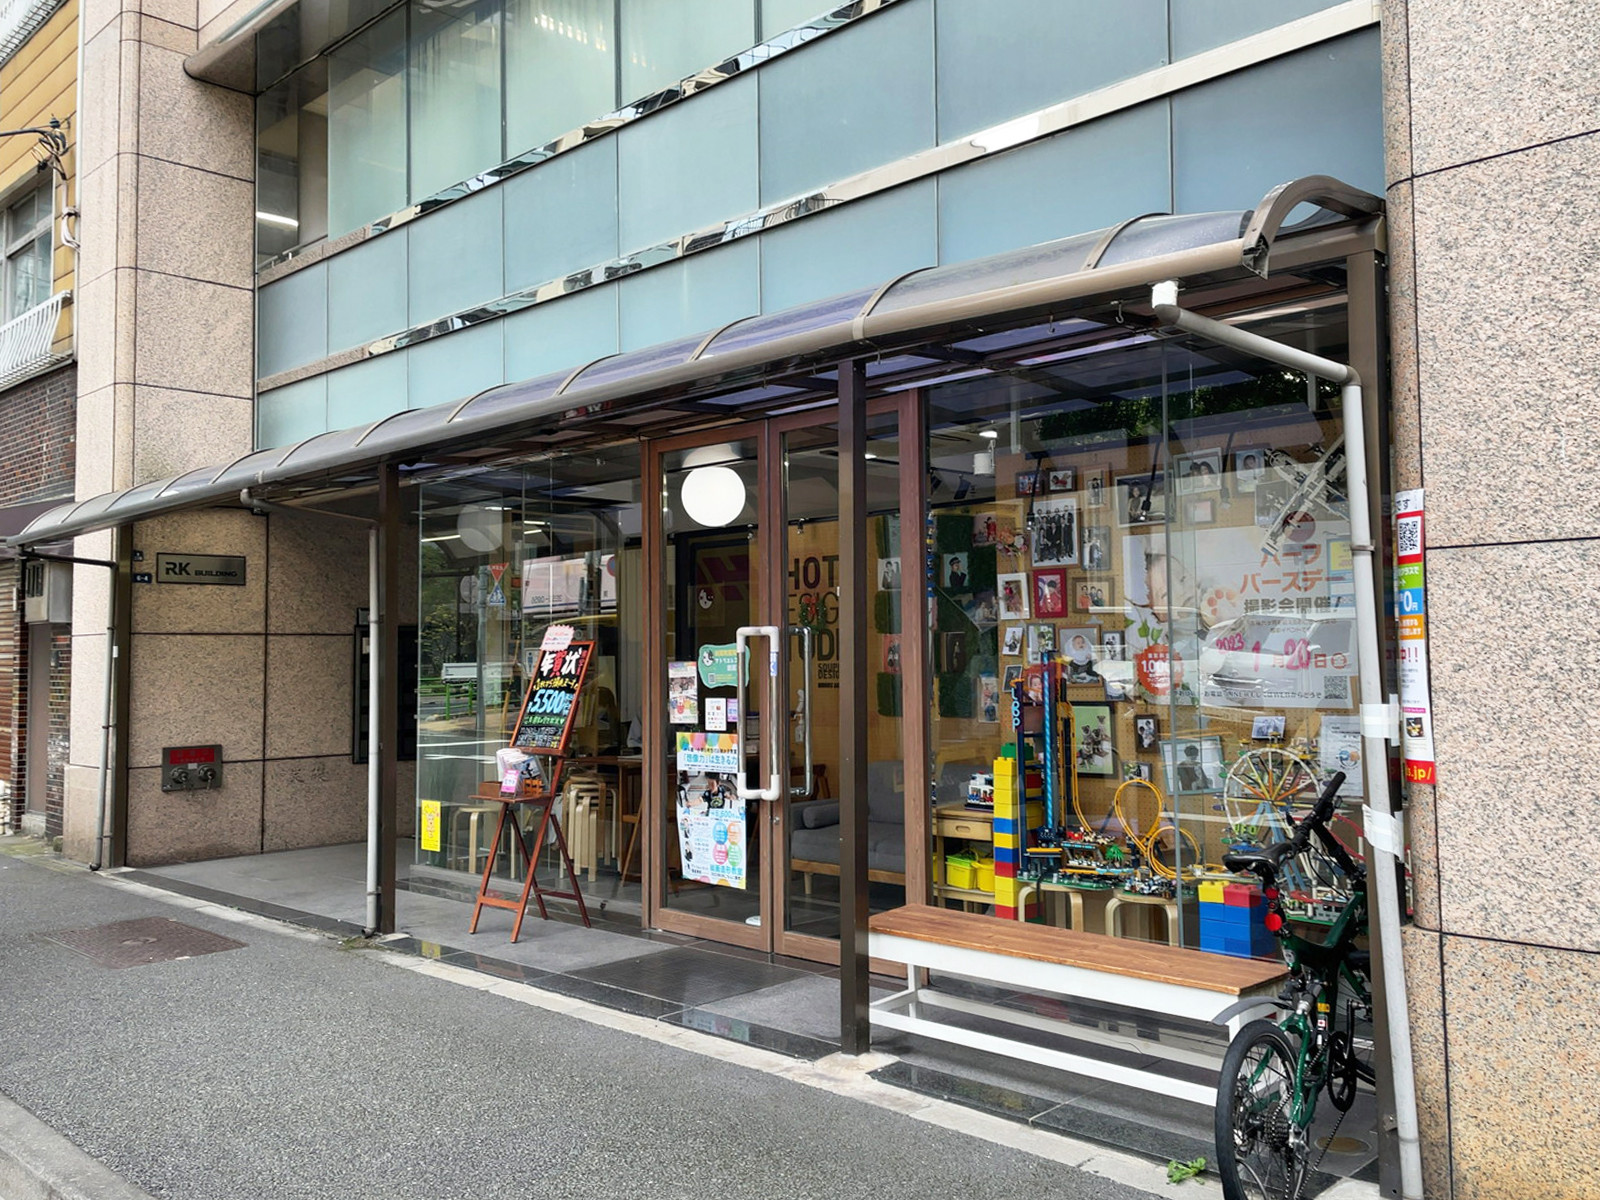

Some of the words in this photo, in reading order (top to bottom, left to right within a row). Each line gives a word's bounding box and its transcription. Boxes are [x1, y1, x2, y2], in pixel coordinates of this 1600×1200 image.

[165, 561, 191, 576] RK
[194, 569, 238, 578] BUILDING
[1240, 569, 1346, 594] バースデー
[1216, 632, 1245, 654] 2023
